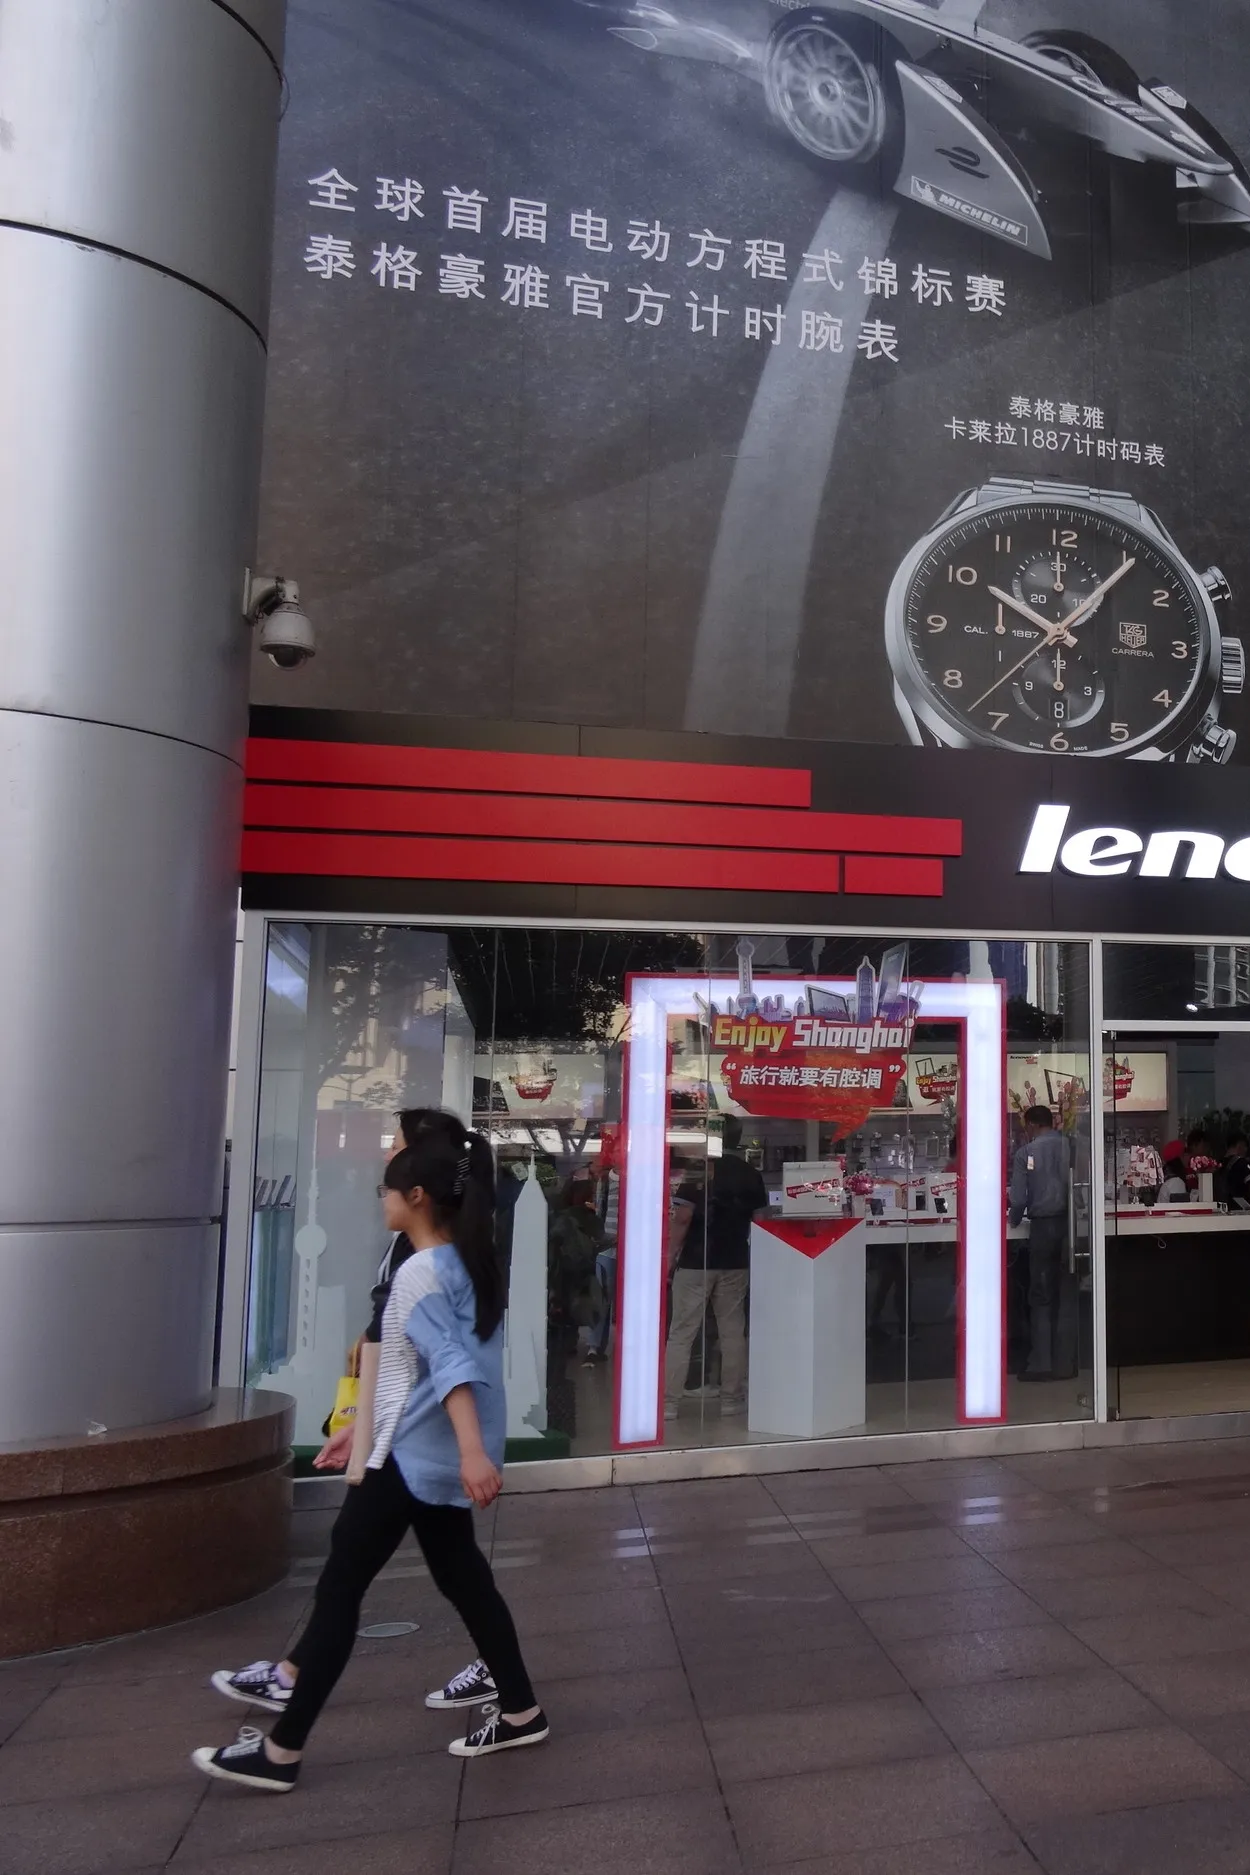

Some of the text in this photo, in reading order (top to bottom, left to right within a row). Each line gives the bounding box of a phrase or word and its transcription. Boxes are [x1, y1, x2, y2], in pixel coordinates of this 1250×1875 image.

[939, 194, 1020, 236] MICHELIN
[307, 166, 1006, 317] 全球首届电动方程式锦标赛
[303, 233, 900, 361] 泰格豪雅官方计时腕表
[1008, 395, 1105, 430] 泰格豪雅
[944, 416, 1166, 468] 卡莱拉1887计时码表
[995, 535, 1011, 553] 11
[1052, 529, 1078, 549] 12
[948, 564, 978, 586] 10
[1030, 594, 1047, 604] 20
[1152, 590, 1169, 608] 2
[926, 614, 948, 634] 9
[964, 625, 1039, 639] CAL. 1887
[1112, 647, 1154, 658] CARRERA
[1171, 640, 1188, 659] 3
[943, 669, 963, 689] 8
[1025, 681, 1034, 690] 9
[1084, 686, 1092, 696] 3
[1152, 689, 1172, 708] 4
[1054, 701, 1064, 718] 8
[988, 711, 1009, 731] 7
[1050, 732, 1069, 751] 6
[1110, 722, 1130, 742] 5
[715, 1016, 915, 1054] Enjoy Shanghai
[726, 1062, 901, 1091] “旅行就要有腔调”
